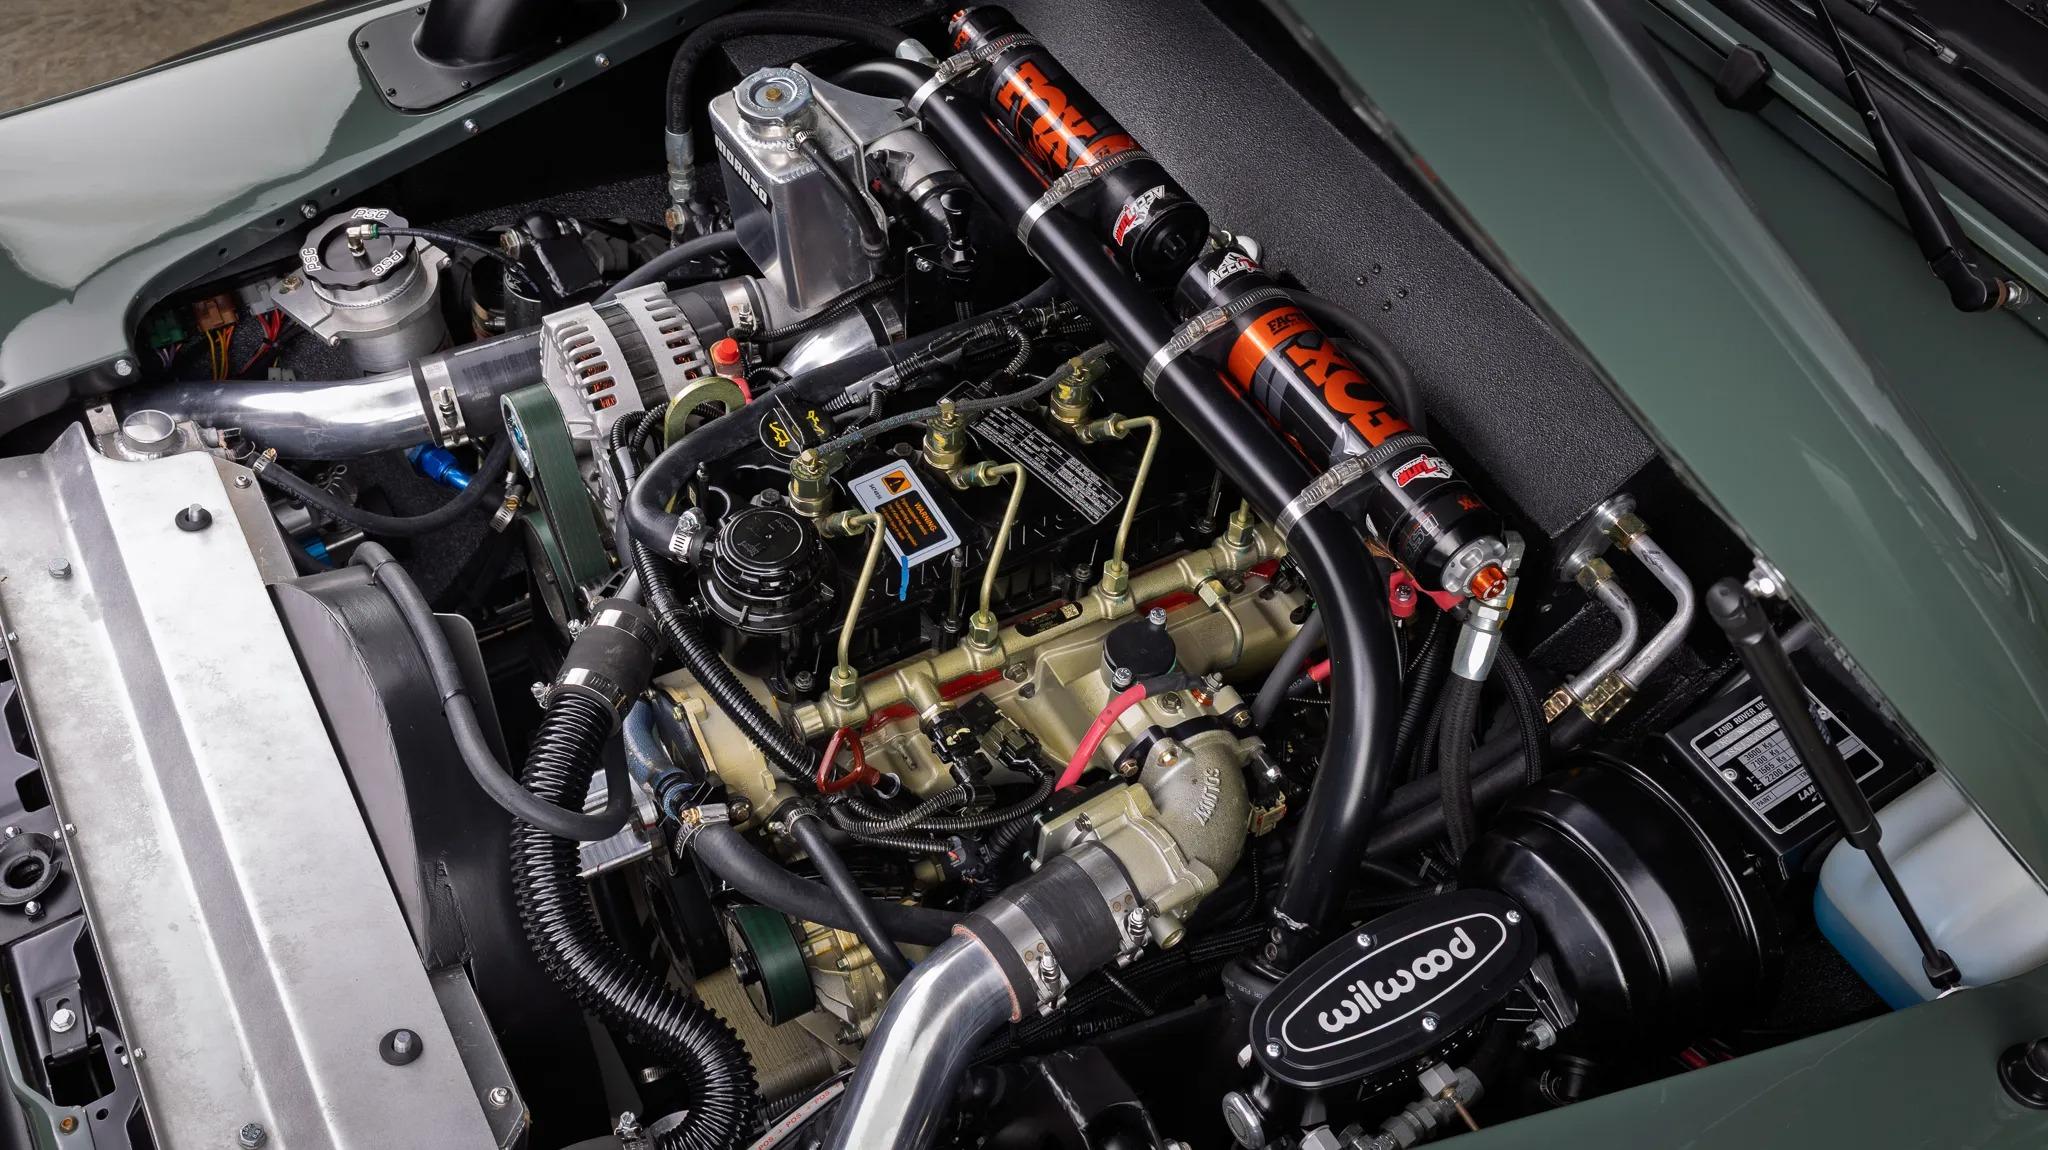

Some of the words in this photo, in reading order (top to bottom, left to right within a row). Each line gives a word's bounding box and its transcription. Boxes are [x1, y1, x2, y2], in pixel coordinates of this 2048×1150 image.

[997, 59, 1098, 170] FOX
[714, 133, 769, 206] MOROSO
[351, 207, 390, 220] PSC
[301, 247, 322, 272] PSC
[371, 249, 404, 276] PSC
[1284, 336, 1414, 449] FOX
[1713, 721, 1734, 738] LAND
[1733, 707, 1757, 725] ROVER
[1755, 700, 1768, 711] UK
[1744, 747, 1762, 761] 3600
[1750, 755, 1768, 769] 7100
[1765, 768, 1784, 783] 2200
[1797, 784, 1817, 802] LAN
[1318, 926, 1476, 1033] wilwood
